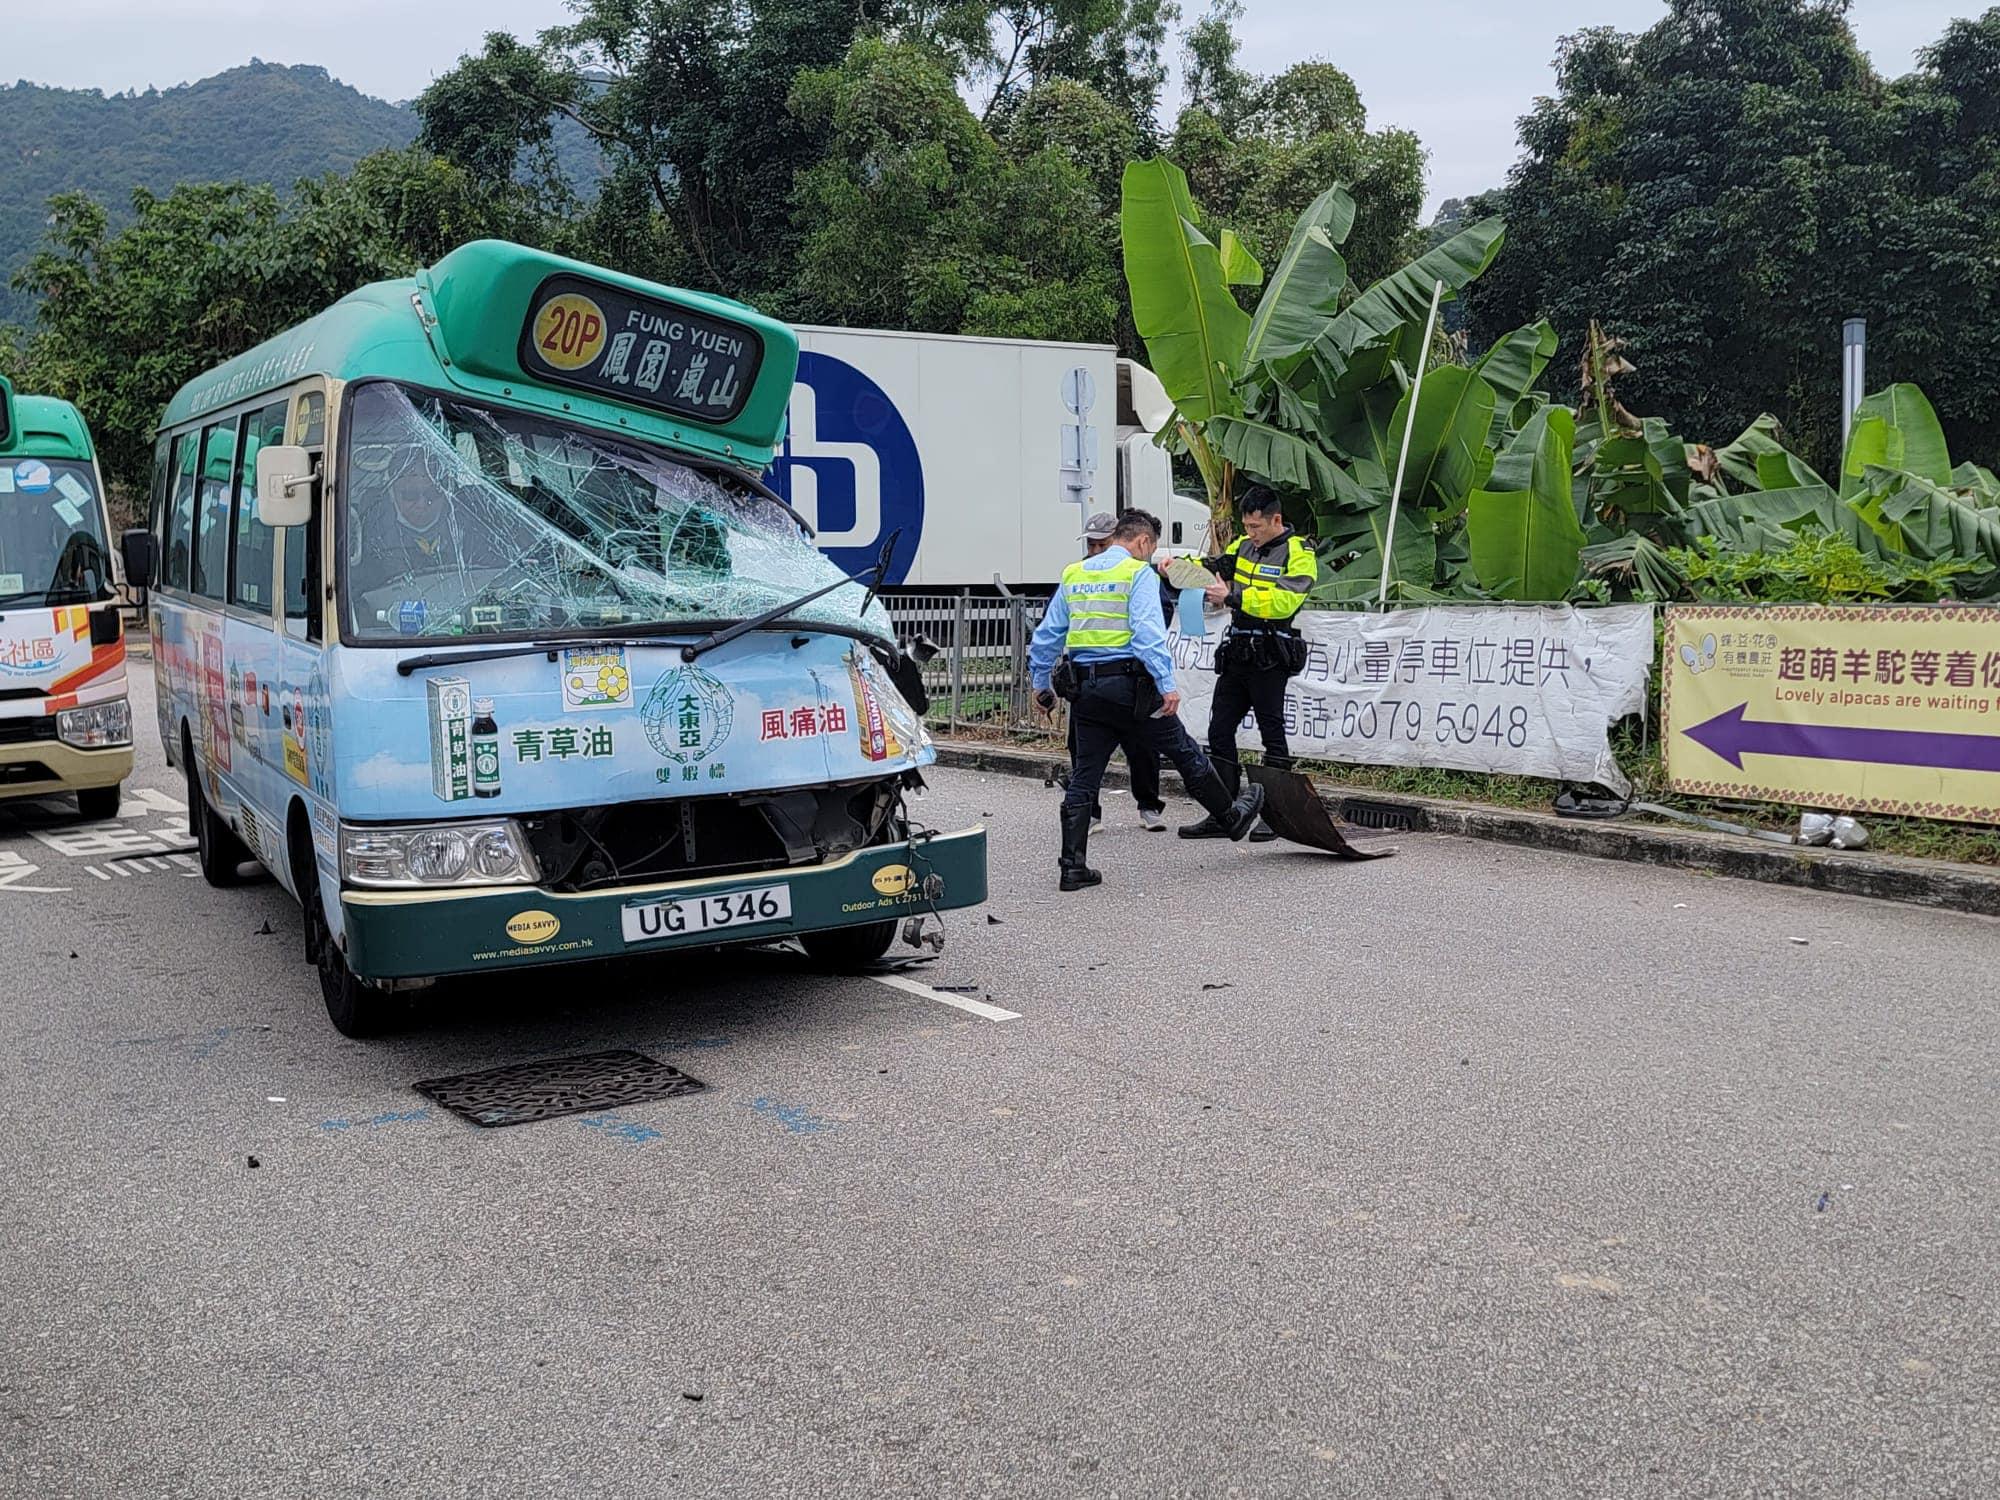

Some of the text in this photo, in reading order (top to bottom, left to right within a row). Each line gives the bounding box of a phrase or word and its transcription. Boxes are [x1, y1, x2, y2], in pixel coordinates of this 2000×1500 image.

[542, 306, 600, 357] 20P
[626, 310, 743, 358] FUNG YUEN
[1080, 584, 1105, 593] POLICE
[1776, 687, 1824, 705] Lovely
[1830, 689, 1890, 706] alpacas
[1895, 695, 1922, 708] are
[1927, 695, 1989, 713] waiting
[678, 694, 700, 747] 大東亞
[761, 703, 847, 740] 風痛油
[1436, 703, 1528, 748] 5048
[513, 726, 613, 761] 青草油
[638, 891, 778, 935] UG 1346
[842, 900, 875, 912] Outdoor
[878, 898, 893, 907] Ads
[508, 920, 556, 932] MEDIA SAVVY
[472, 938, 593, 961] www.mediasavvy.com.hk
